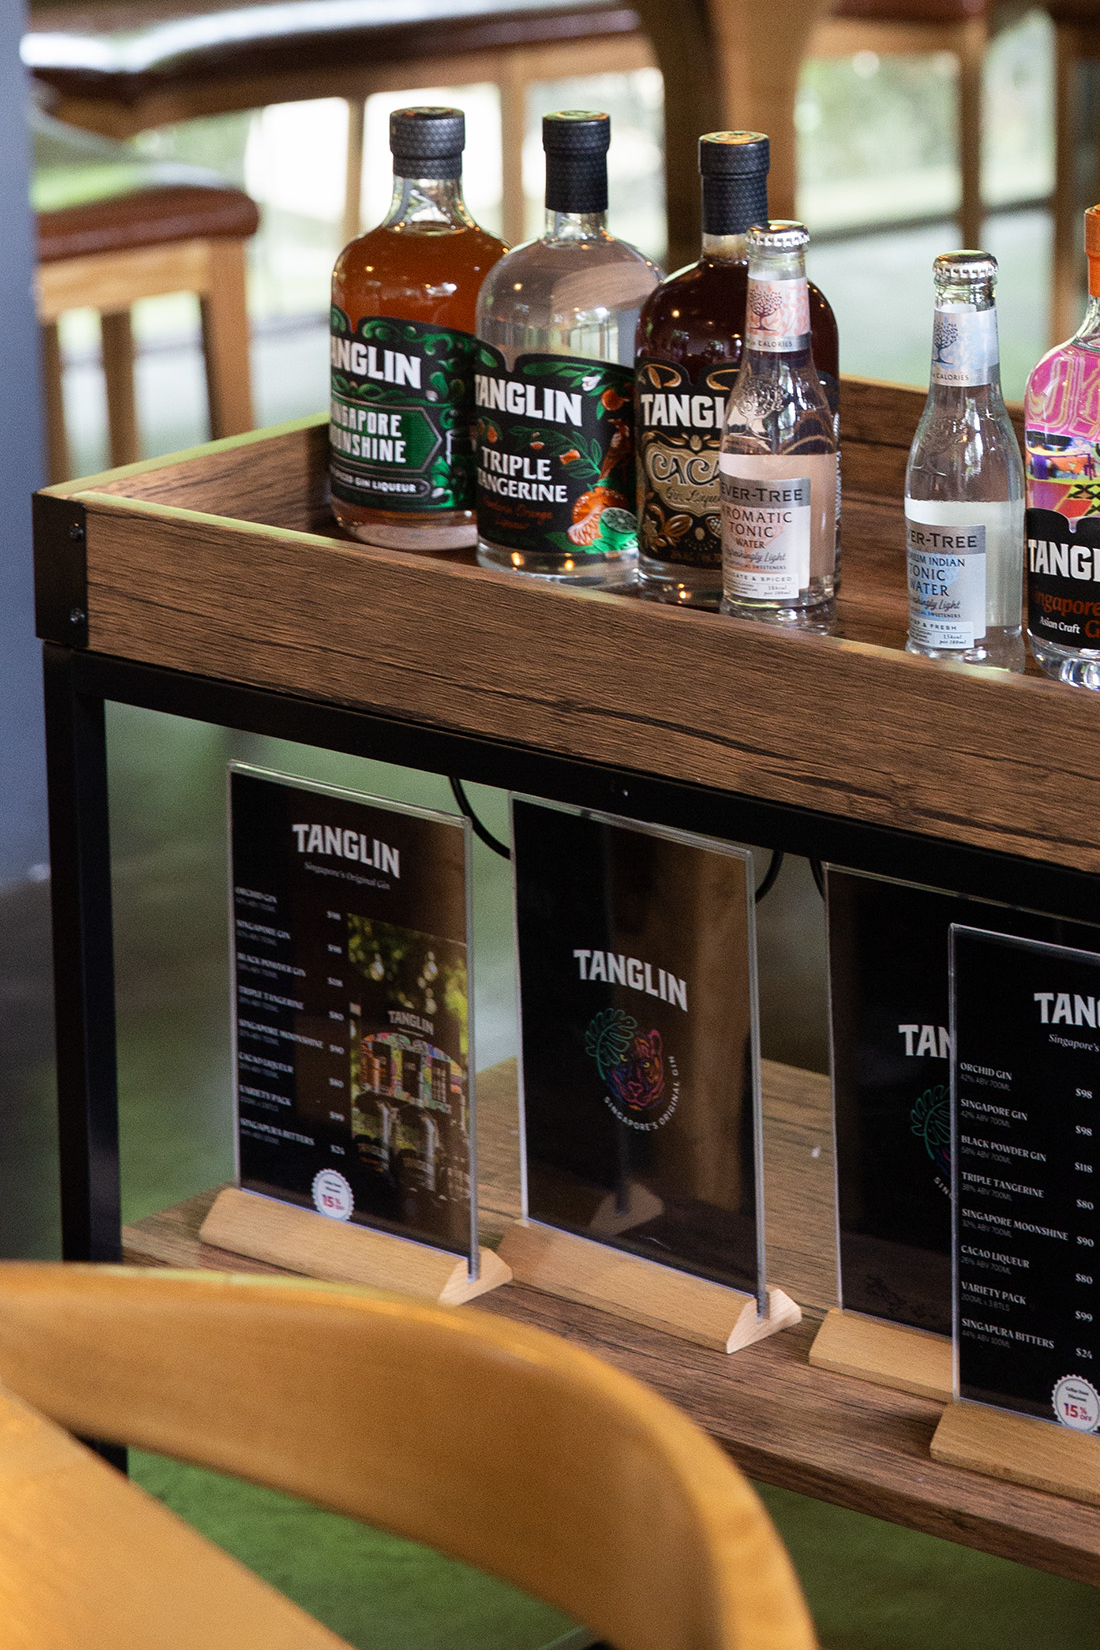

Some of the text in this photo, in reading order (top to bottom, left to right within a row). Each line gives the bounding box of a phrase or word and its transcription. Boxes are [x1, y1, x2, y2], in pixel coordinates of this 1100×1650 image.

[936, 373, 969, 381] CALORIES
[475, 374, 582, 427] TANGLIN
[481, 446, 552, 481] TRIPLE
[372, 480, 417, 493] LIQUEUR
[721, 482, 803, 502] EVER-TREE
[729, 522, 773, 537] TONIC
[910, 530, 977, 548] ER-TREE
[736, 538, 765, 548] WATER
[764, 552, 786, 564] Light
[929, 557, 965, 567] INDIAN
[938, 599, 960, 611] Light
[1039, 616, 1081, 635] Asian Craft
[292, 823, 401, 879] TANGLIN
[573, 949, 688, 1012] TANGLIN
[387, 1010, 434, 1035] TANGLIN
[1048, 1033, 1100, 1052] Singapore's
[960, 1061, 1013, 1082] ORCHID GIN
[1075, 1087, 1093, 1099] $98
[659, 1081, 680, 1125] ORIGINAL
[960, 1098, 1028, 1121] SINGAPORE GIN
[603, 1095, 659, 1132] SINGAPORE'S
[1075, 1124, 1093, 1137] $98
[961, 1134, 1047, 1163] BLACK POWDER GIN
[1074, 1161, 1093, 1174] $118
[961, 1171, 992, 1186] TRIPLE
[993, 1178, 1045, 1199] TANGERINE
[1076, 1198, 1094, 1211] $80
[961, 1208, 1094, 1248] SINGAPORE MOONSHINE $90
[960, 1244, 1030, 1269] CACAO LIQUEUR
[1075, 1273, 1093, 1285] $80
[961, 1281, 1027, 1306] VARIETY PACK
[1075, 1310, 1093, 1323] $99
[961, 1317, 1055, 1350] SINGAPURA BITTERS
[1075, 1347, 1093, 1360] $24
[1064, 1403, 1087, 1418] 15 %
[1080, 1414, 1092, 1423] OFF
